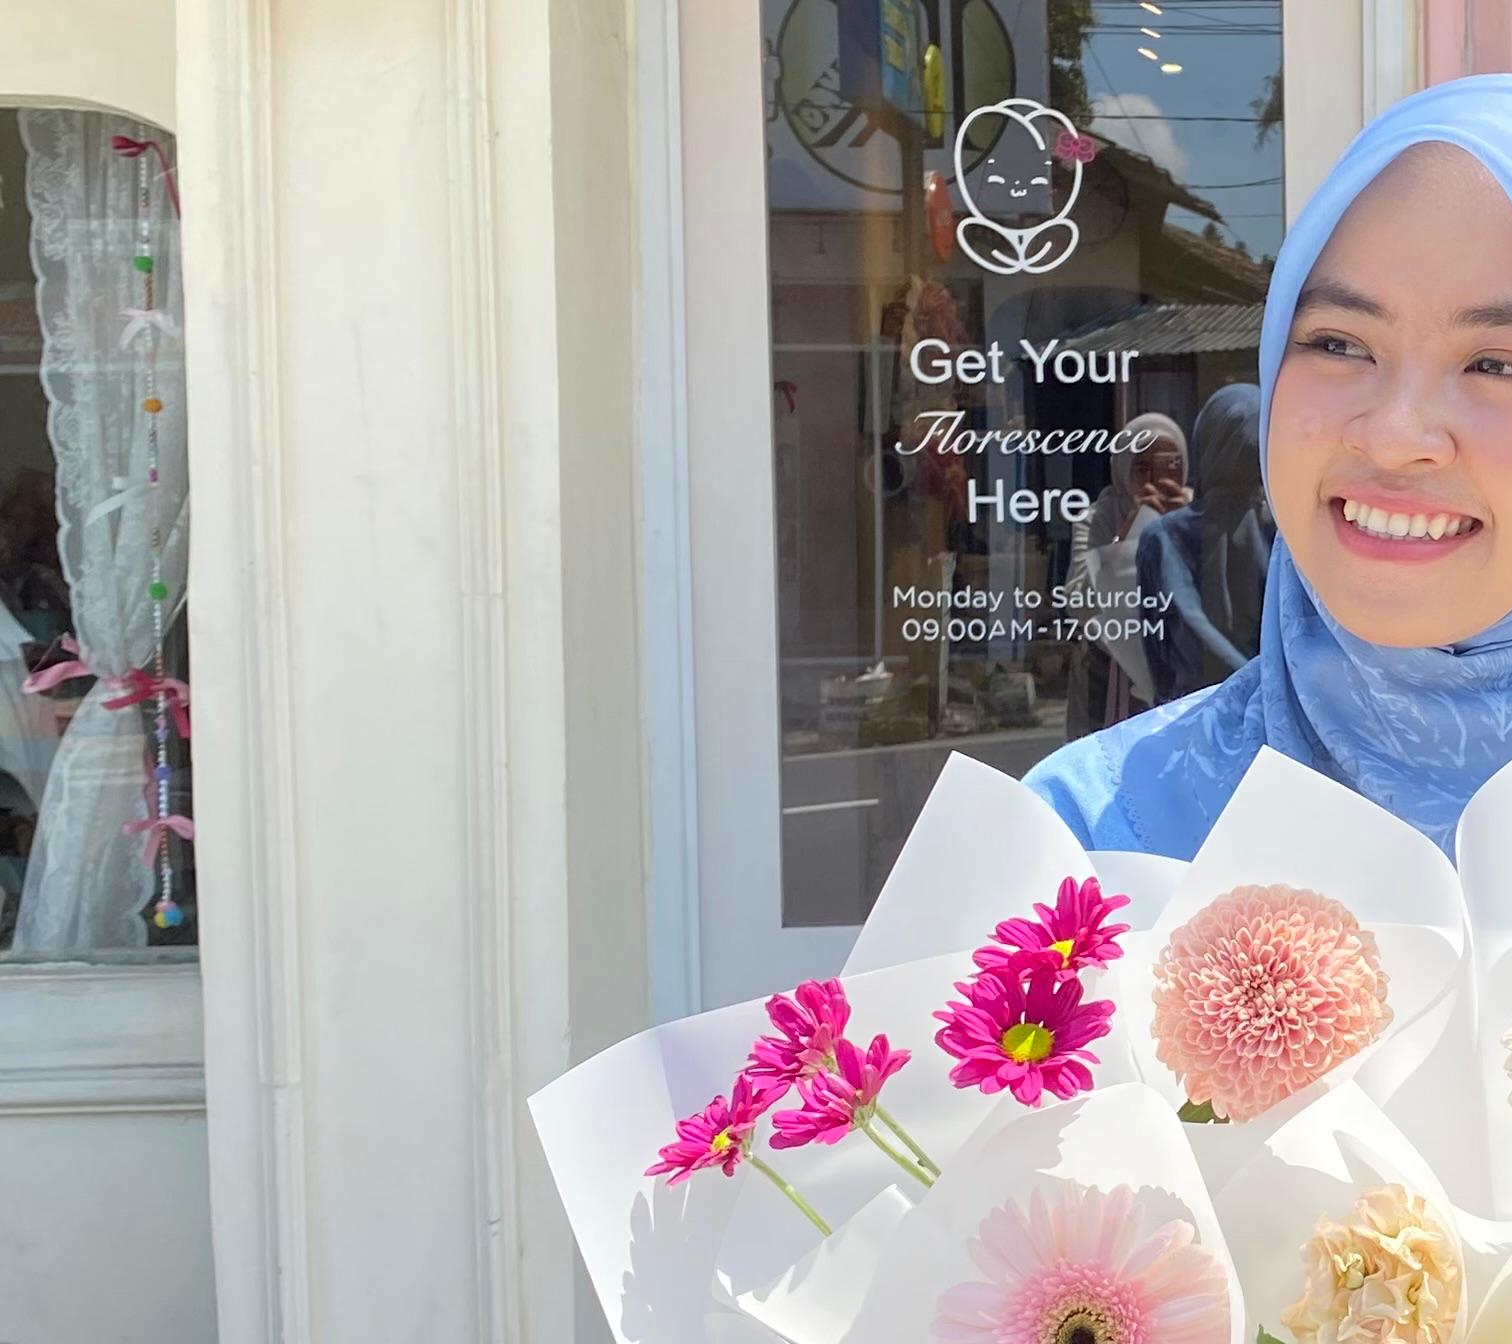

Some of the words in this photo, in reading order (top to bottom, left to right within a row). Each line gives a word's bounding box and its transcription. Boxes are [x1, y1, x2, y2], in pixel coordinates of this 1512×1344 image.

[910, 338, 1005, 384] Get
[1020, 339, 1139, 384] Your
[895, 410, 1159, 456] Florescence
[968, 479, 1090, 523] Here
[893, 586, 1004, 612] Monday
[1014, 587, 1041, 608] to
[1052, 586, 1173, 612] Saturday
